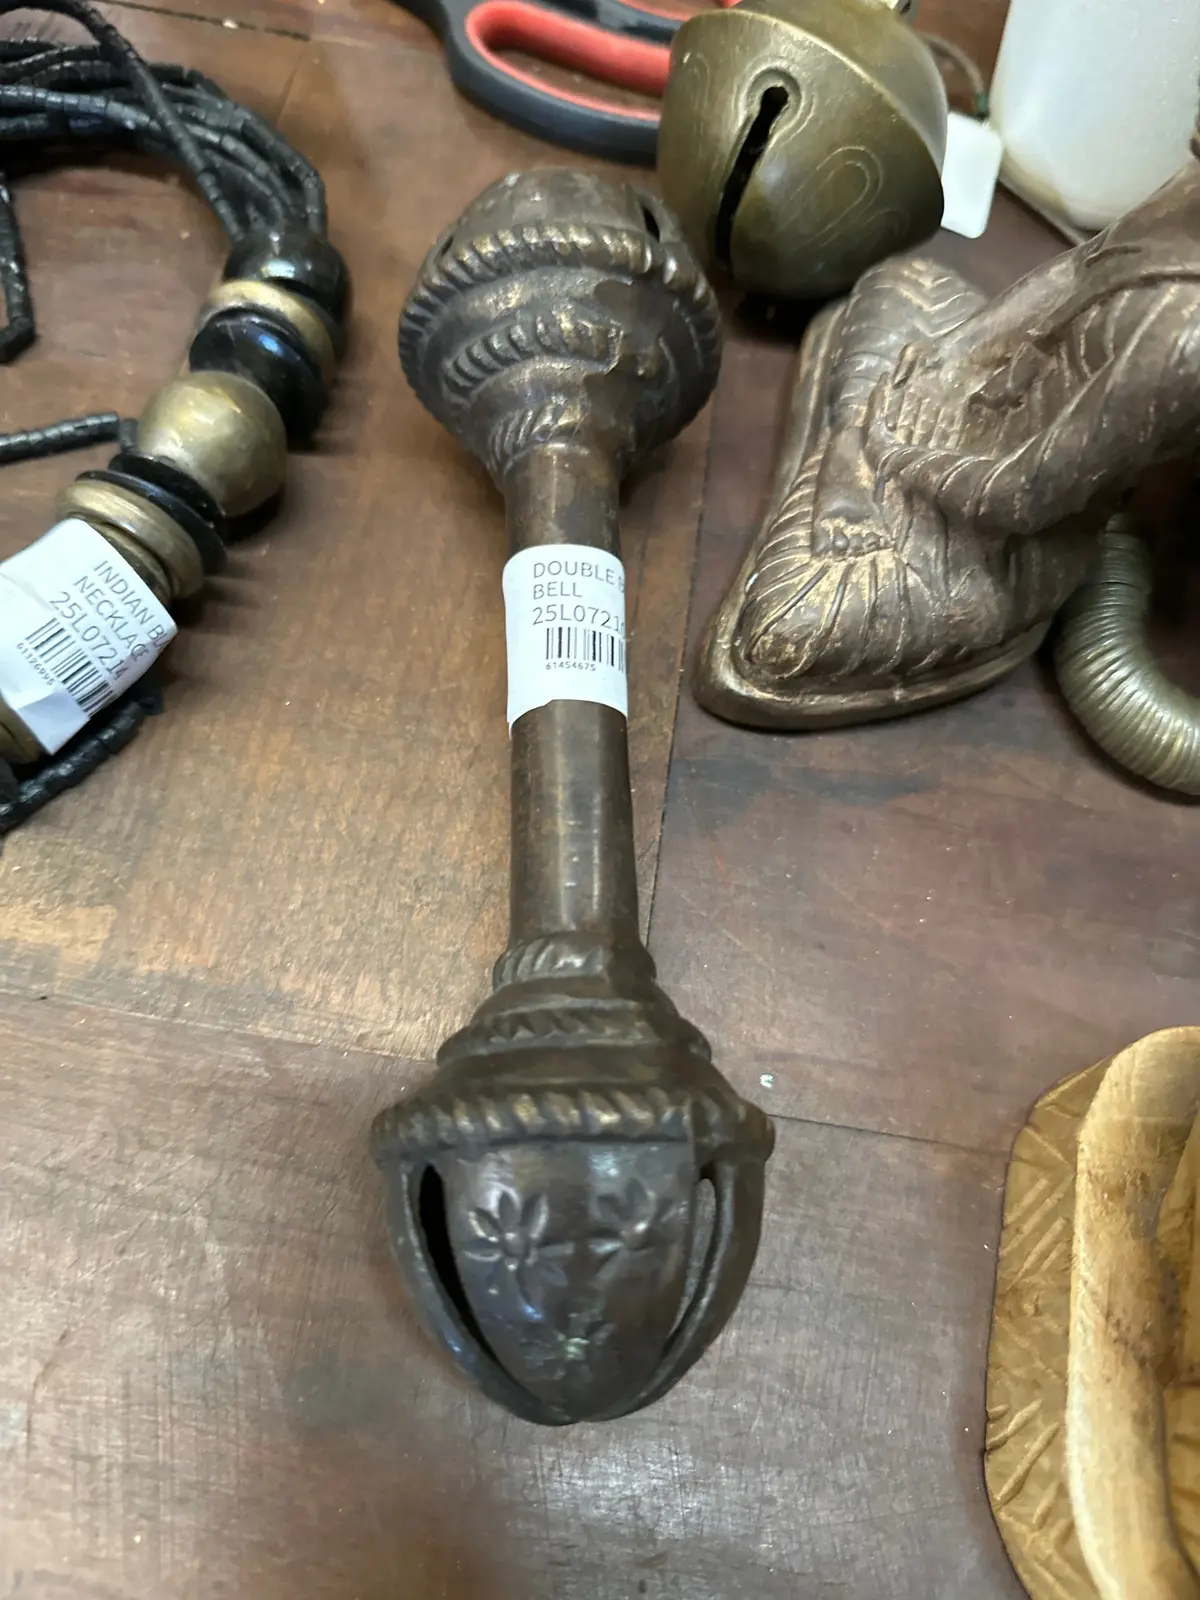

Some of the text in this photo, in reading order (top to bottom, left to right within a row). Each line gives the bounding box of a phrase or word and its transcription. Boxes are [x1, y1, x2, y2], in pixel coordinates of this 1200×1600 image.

[533, 560, 615, 586] DOUBLE
[93, 560, 155, 625] INDIAN
[533, 581, 583, 600] BELL
[73, 575, 150, 662] NECKLACE
[545, 661, 597, 672] 61454675
